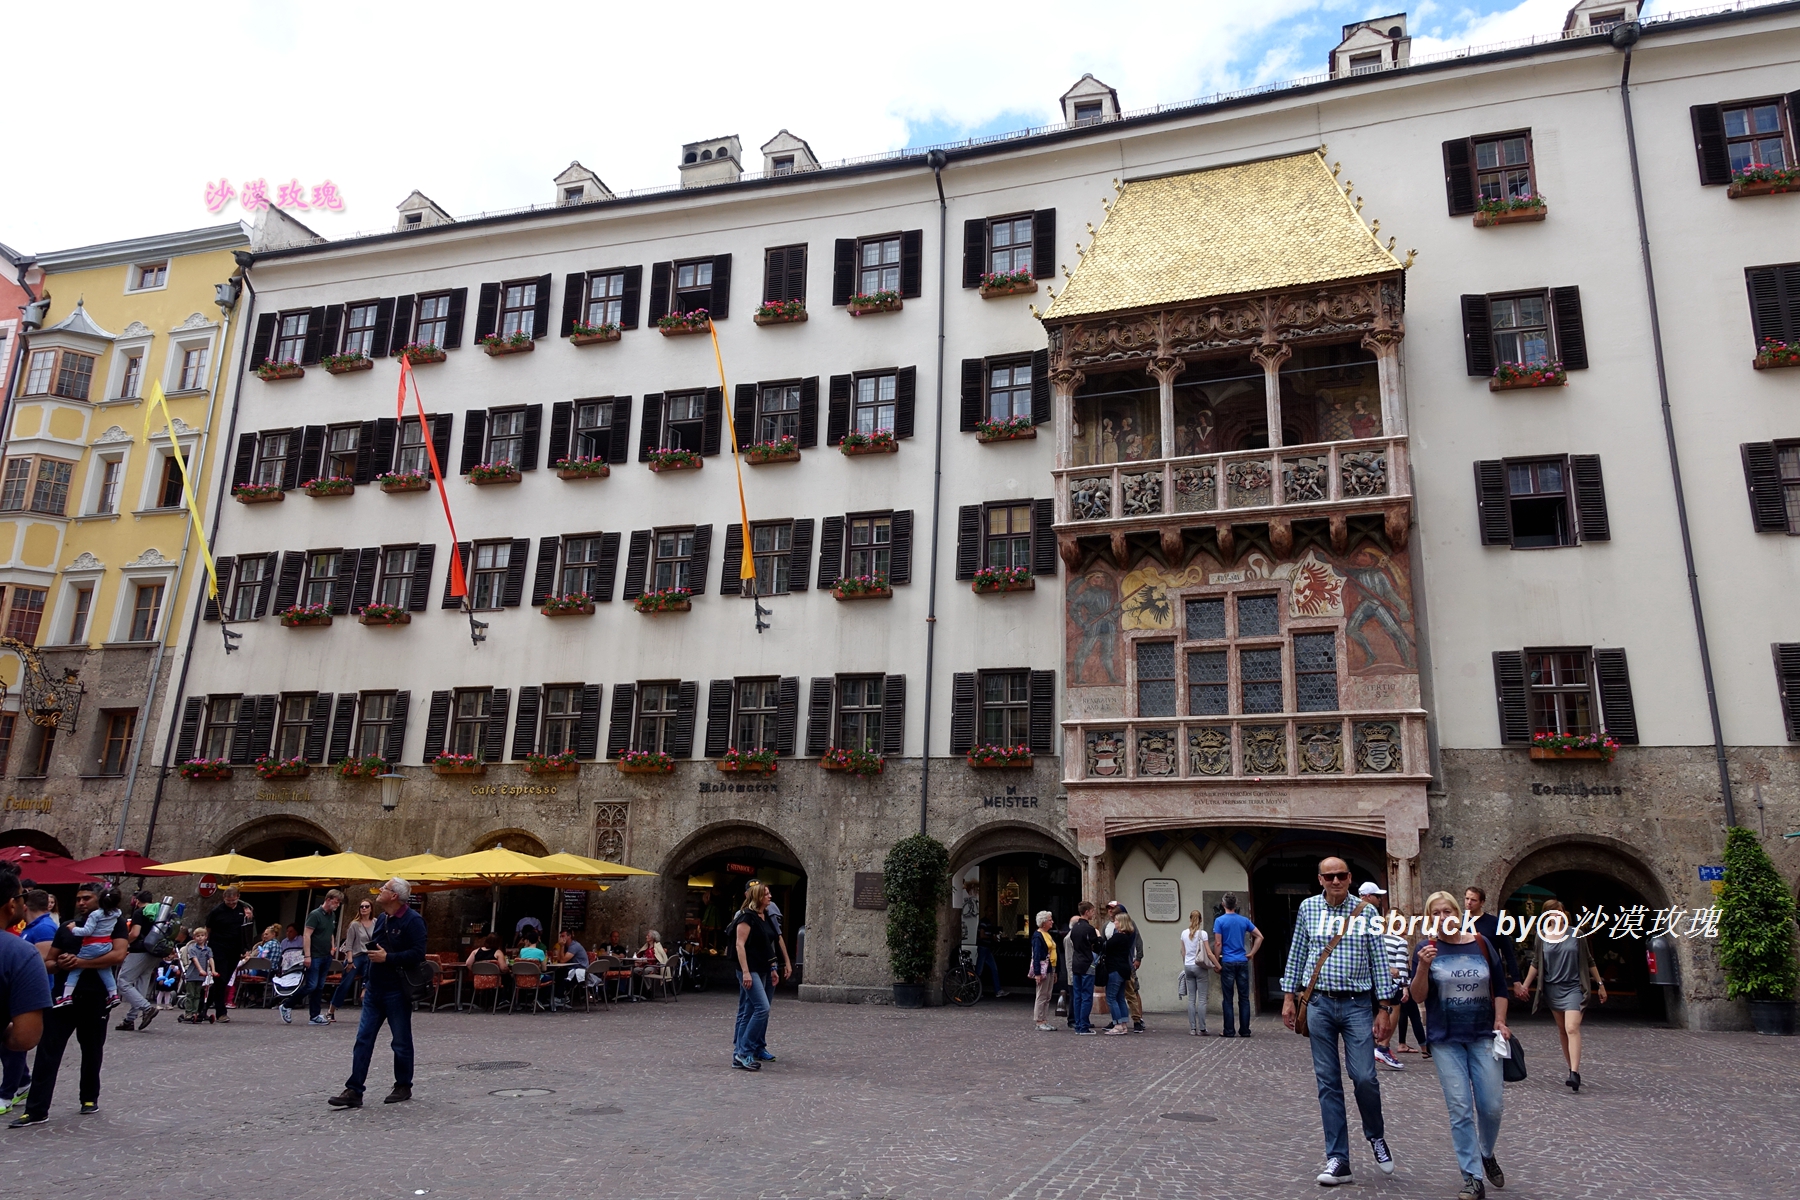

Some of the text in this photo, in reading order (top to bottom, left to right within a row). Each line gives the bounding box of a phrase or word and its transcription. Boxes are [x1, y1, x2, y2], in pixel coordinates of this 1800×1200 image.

[500, 785, 557, 796] Espresso
[699, 782, 778, 793] Modewaren
[983, 796, 1039, 808] MEISTER
[1440, 835, 1454, 849] 15
[1451, 969, 1480, 978] NEVER
[1455, 983, 1479, 992] STOP
[1446, 996, 1489, 1006] DREAMING
